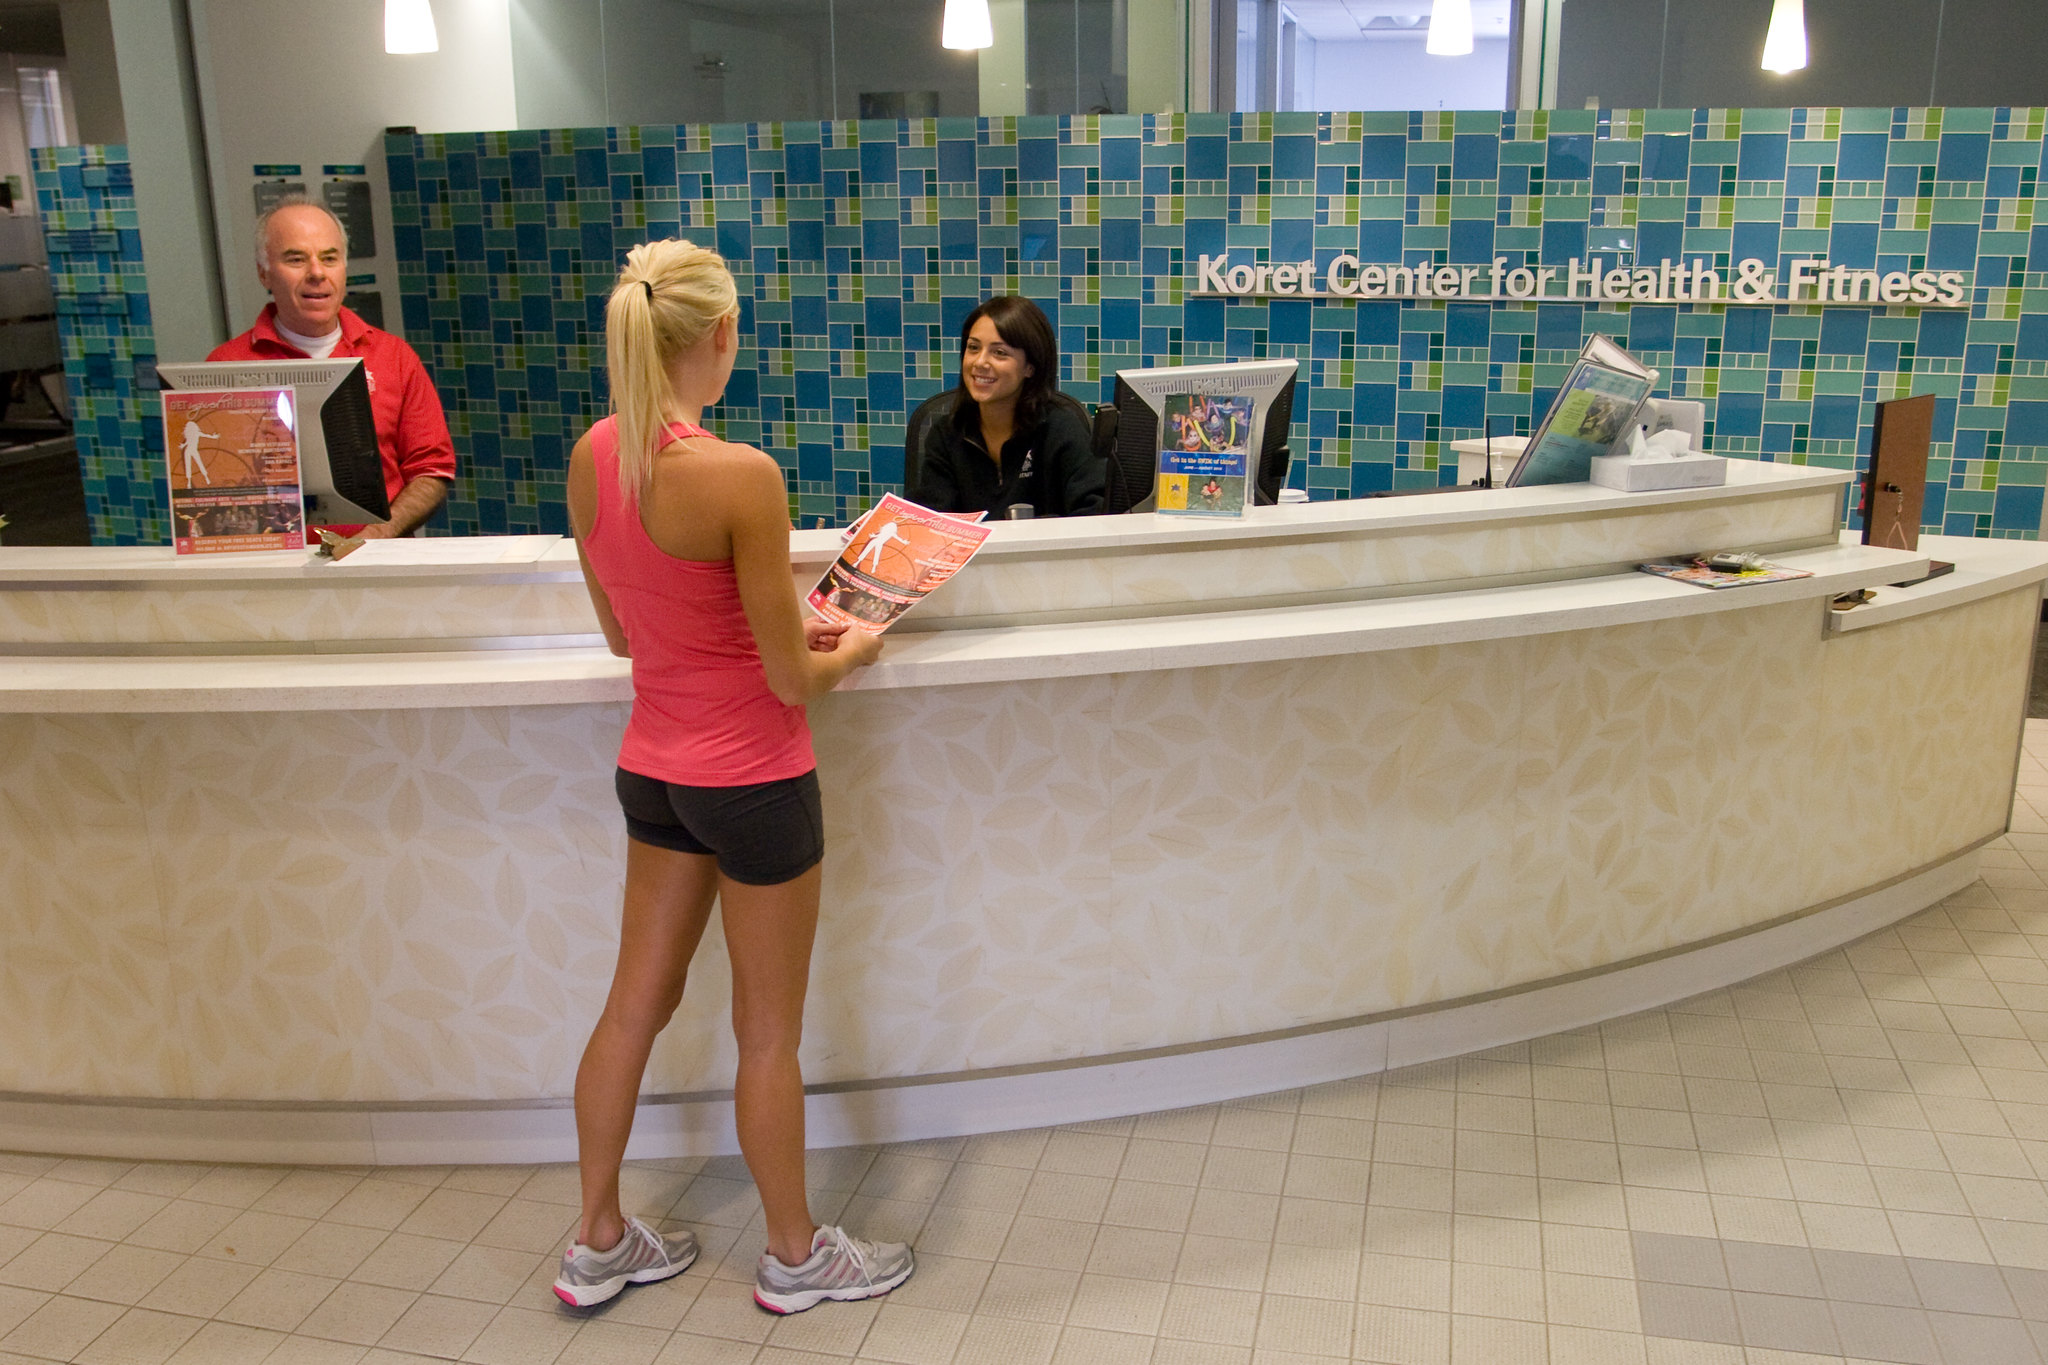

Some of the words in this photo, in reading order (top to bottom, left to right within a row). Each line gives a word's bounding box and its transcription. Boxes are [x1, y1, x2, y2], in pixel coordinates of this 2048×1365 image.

[1199, 253, 1316, 295] Koret
[1326, 254, 1478, 297] Center
[1489, 257, 1555, 299] for
[1567, 257, 1720, 301] Health
[1733, 258, 1776, 301] &
[1789, 259, 1965, 304] Fitness
[885, 502, 903, 513] GET
[928, 519, 947, 531] THIS
[946, 525, 985, 540] SUMMER!
